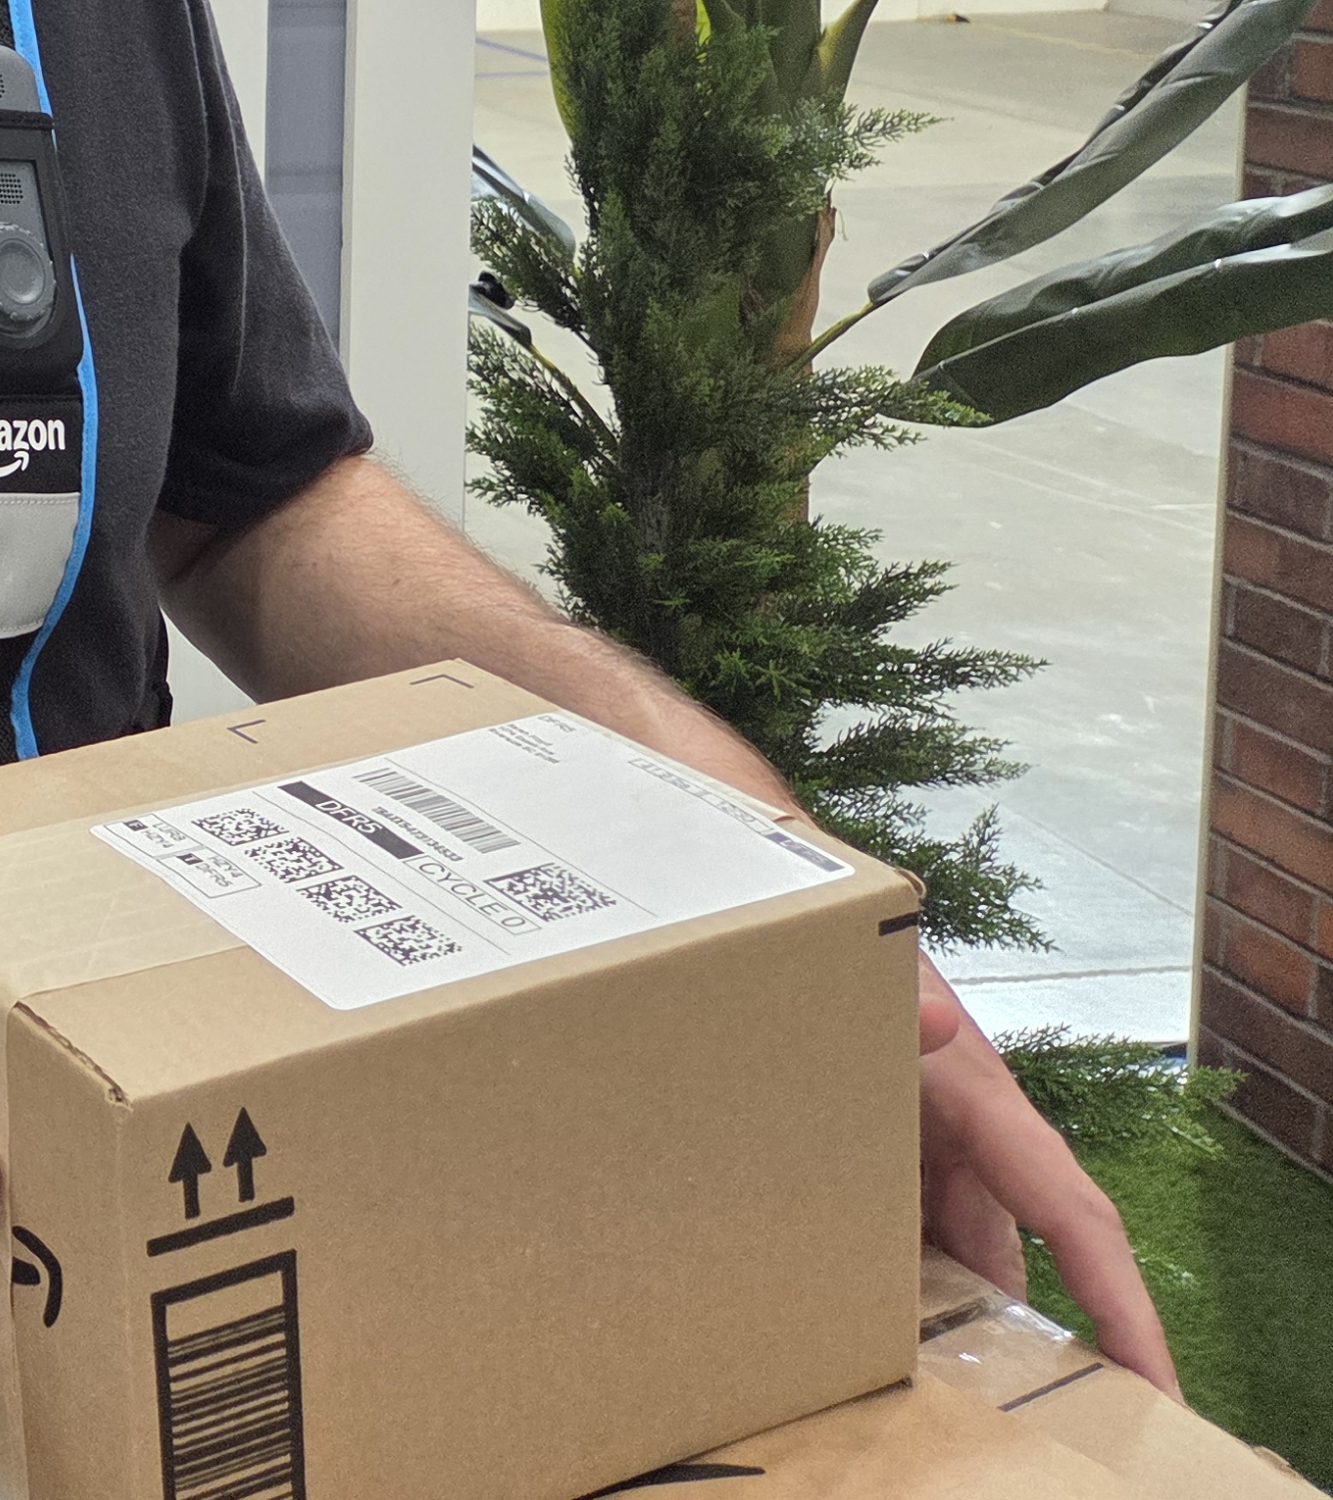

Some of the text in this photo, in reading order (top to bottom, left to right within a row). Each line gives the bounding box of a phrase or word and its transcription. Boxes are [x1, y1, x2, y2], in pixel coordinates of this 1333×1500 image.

[315, 801, 383, 834] DFR5
[195, 864, 233, 887] DFR5
[208, 855, 244, 878] HZY4
[418, 862, 507, 917] CYCLE
